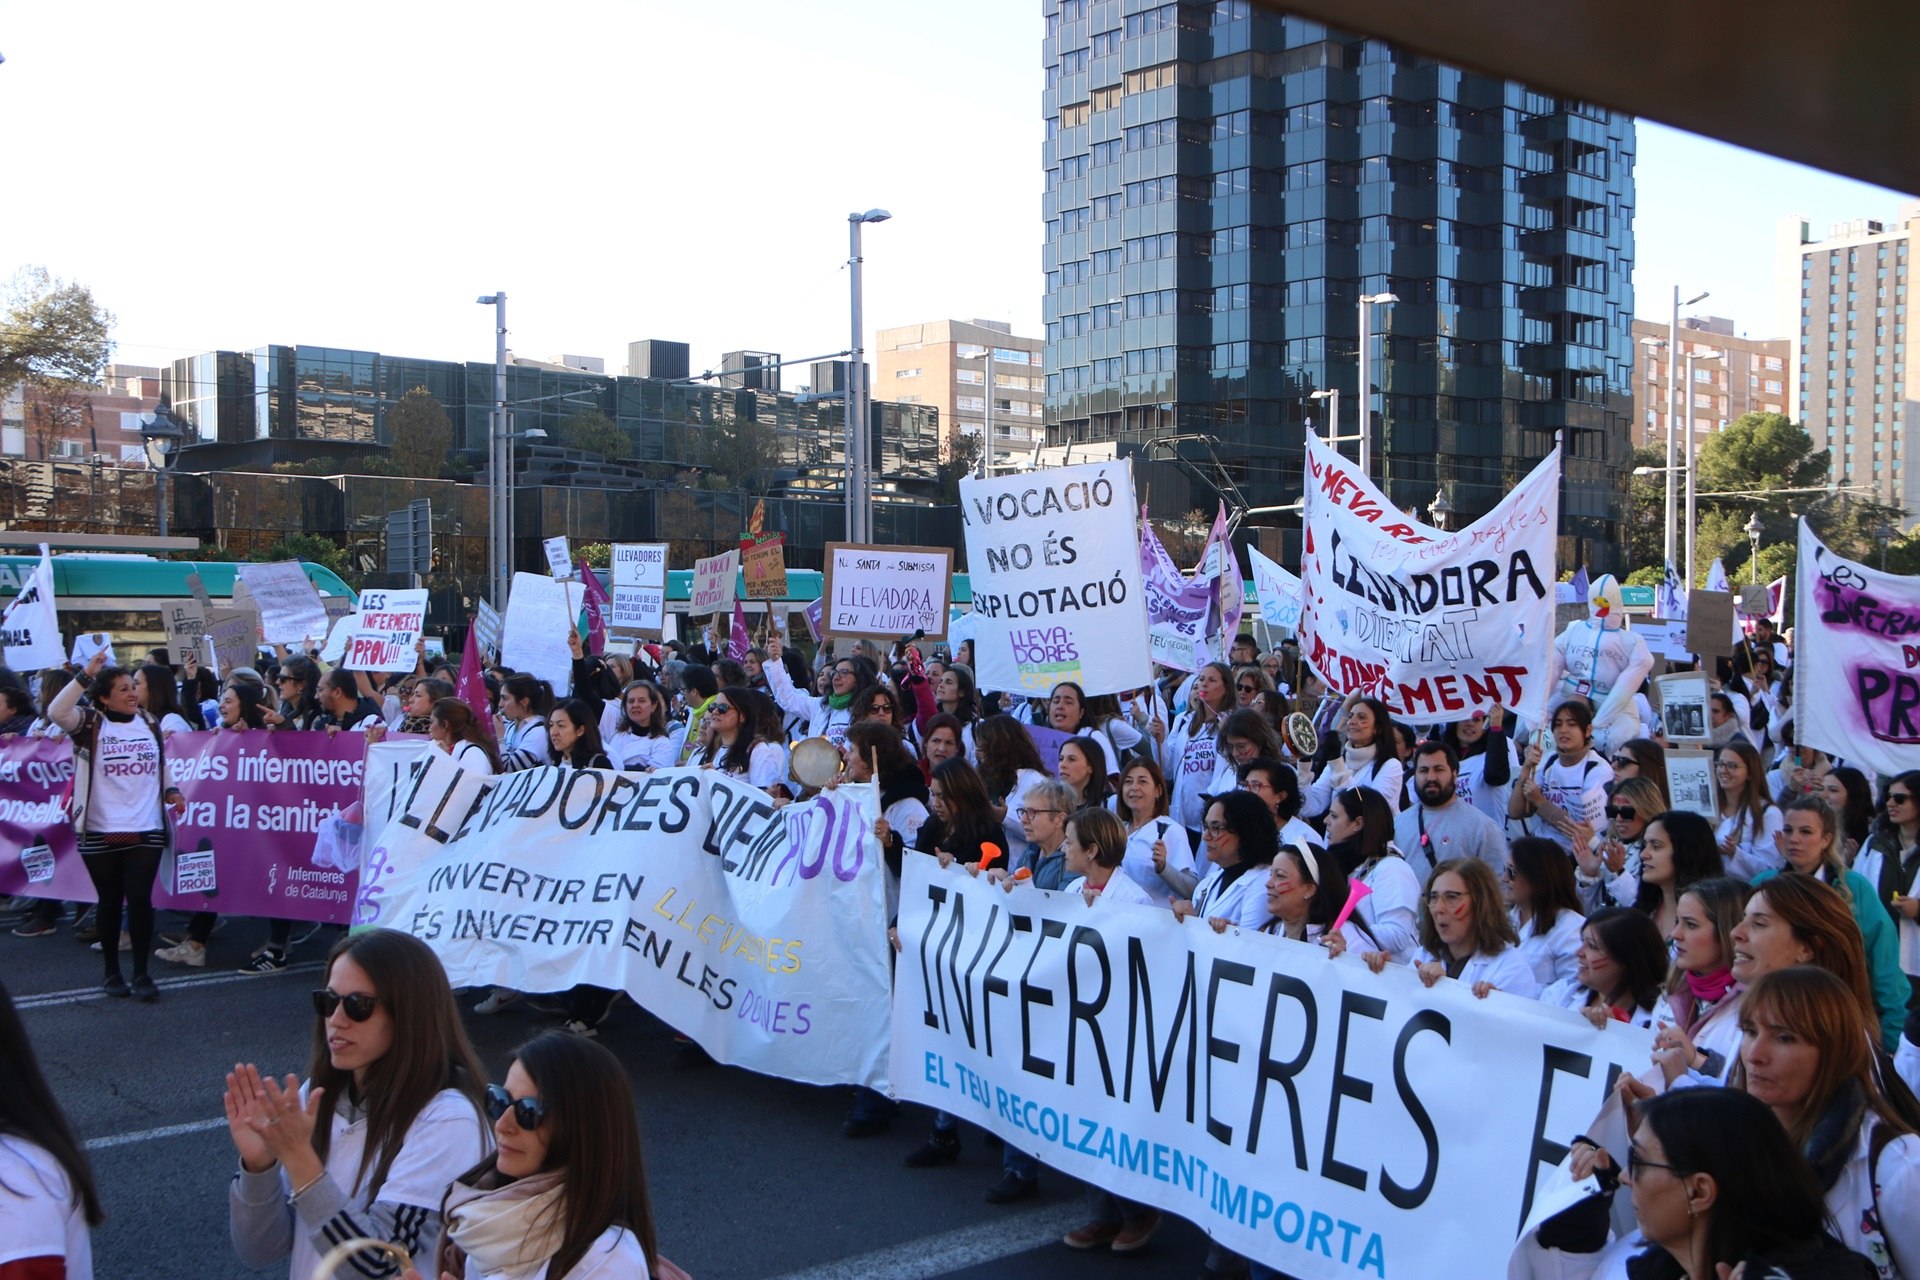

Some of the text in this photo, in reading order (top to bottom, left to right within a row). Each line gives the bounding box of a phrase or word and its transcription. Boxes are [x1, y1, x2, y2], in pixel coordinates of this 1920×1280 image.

[973, 469, 1114, 525] VOCACIÓ
[1321, 464, 1384, 524] MEVA
[617, 549, 662, 563] LLEVADORES
[855, 559, 880, 570] SANTA
[986, 530, 1077, 574] NO ÉS
[362, 594, 387, 611] LES
[841, 586, 931, 611] LLEVADORA
[972, 569, 1127, 618] EXPLOTACIÓ
[362, 613, 422, 632] INFERMERES
[838, 613, 859, 626] EN
[391, 632, 412, 646] DIEM
[352, 639, 401, 666] PROU!!!
[1013, 643, 1079, 664] DORES
[236, 748, 365, 787] infermeres
[225, 795, 250, 829] la
[179, 877, 214, 892] PROU!
[287, 866, 345, 885] Infermeres
[428, 861, 586, 906] INVERTIR
[592, 872, 645, 904] EN
[285, 884, 348, 904] de Catalunya
[410, 903, 812, 1035] ÉS INVERTIR EN LES DONES
[919, 883, 1453, 1211] INFERMERES
[925, 1051, 1386, 1280] EL TEU RECOLZAMENT IMPORTA
